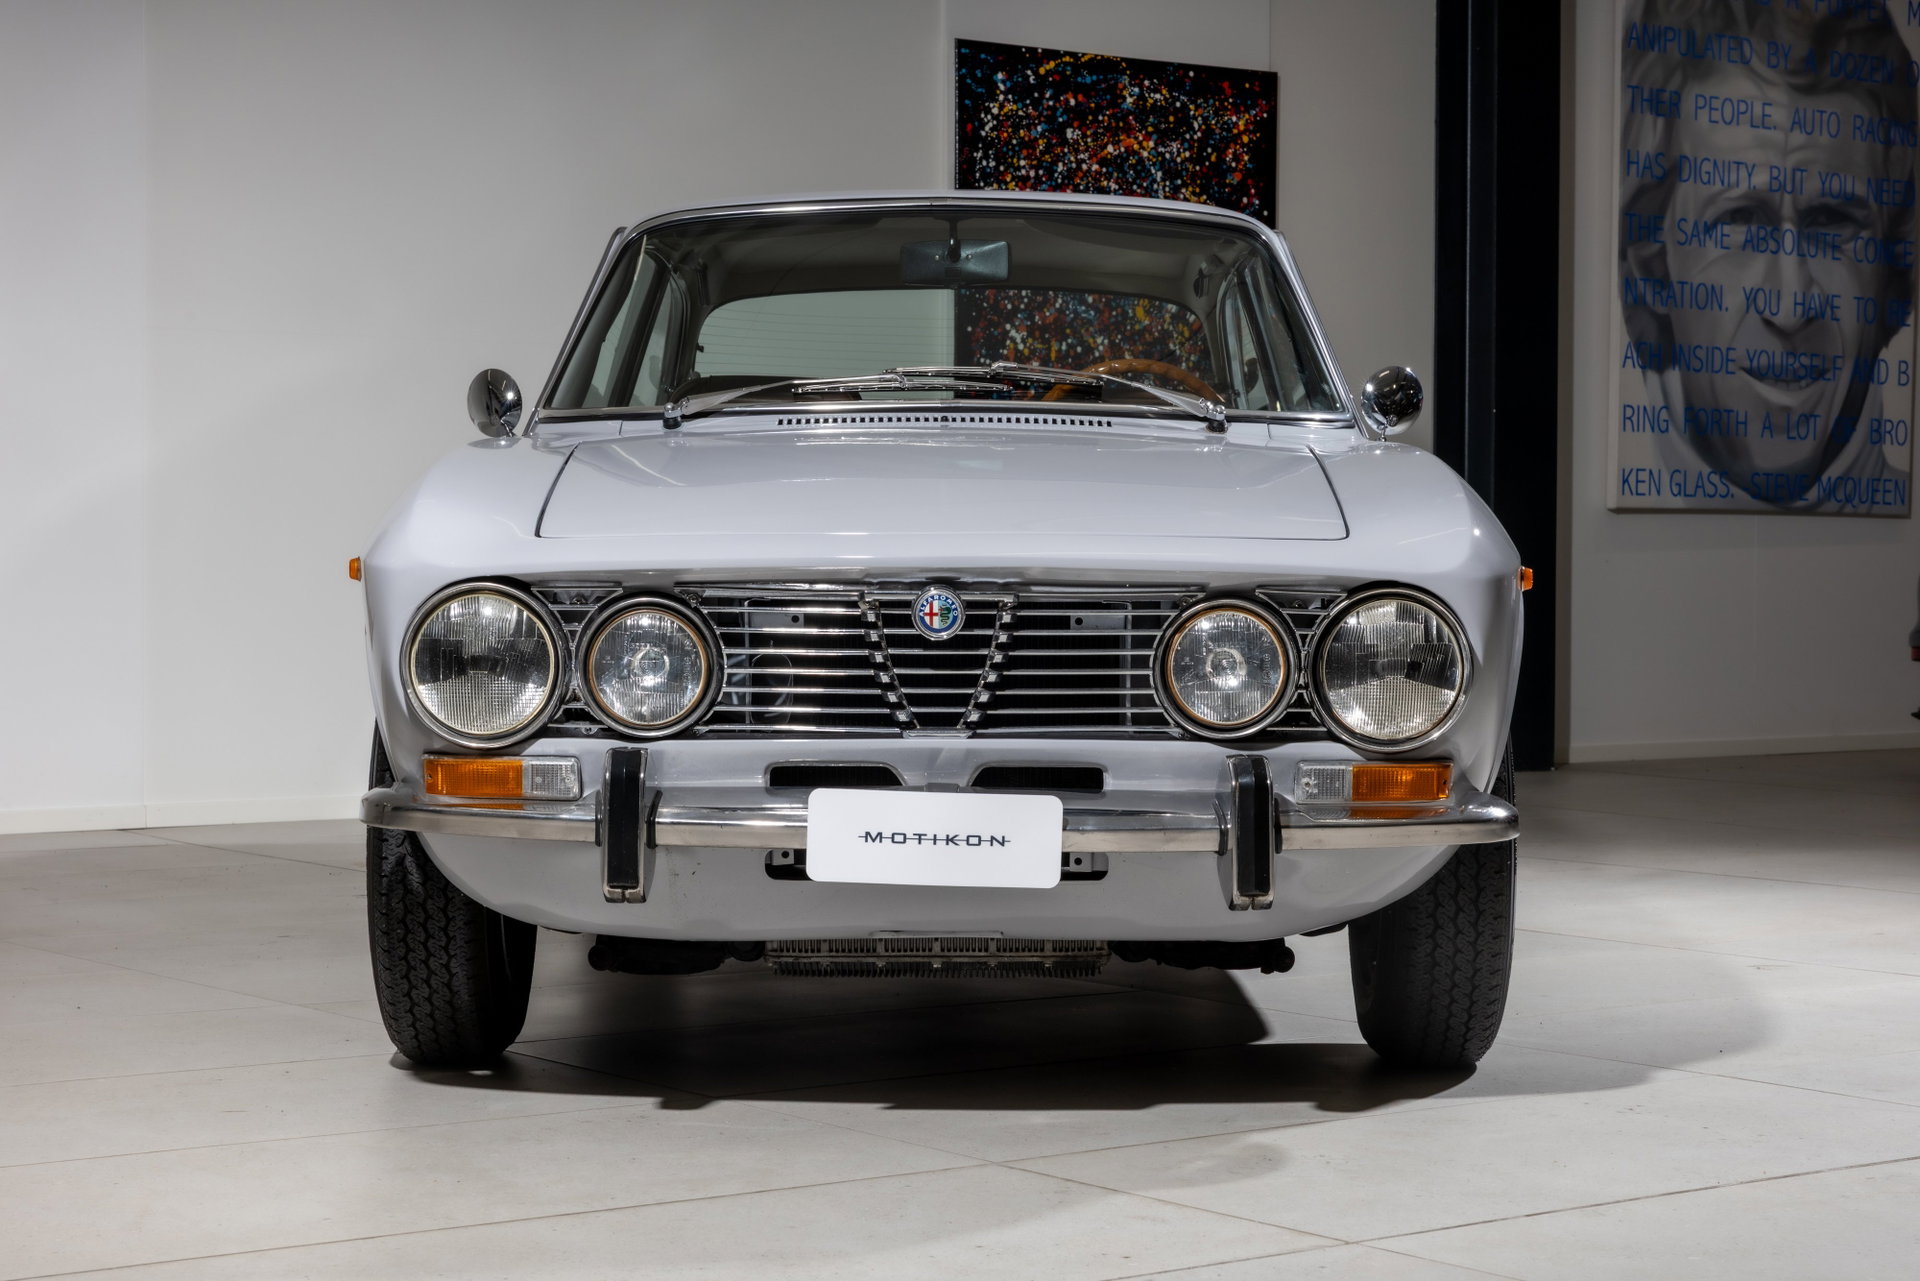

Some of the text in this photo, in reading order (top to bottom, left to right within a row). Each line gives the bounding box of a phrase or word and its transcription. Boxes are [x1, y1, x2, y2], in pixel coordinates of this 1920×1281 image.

[1628, 22, 1919, 88] ANIPULATED BY A DOZEN O
[1627, 85, 1919, 147] THER PEOPLE. AUTO RACING
[1626, 149, 1916, 208] HAS DIGNITY. BUT YOU NEED
[1625, 213, 1914, 269] THE SAME ABSOLUTE CONCE
[1624, 277, 1730, 313] NTRATION.
[1742, 286, 1781, 317] YOU
[1794, 292, 1841, 322] HAVE
[1854, 296, 1879, 325] TO
[1622, 341, 1911, 387] ACH INSIDE YOURSELF AND B
[1622, 404, 1669, 434] RING
[1683, 406, 1748, 438] FORTH
[1760, 411, 1774, 439] A
[1786, 413, 1821, 441] LOT
[1870, 418, 1909, 447] BRO
[1621, 468, 1661, 497] KEN
[1669, 468, 1735, 499] GLASS.
[1817, 475, 1907, 509] MCQUEEN
[864, 831, 1006, 847] MOTIKON
